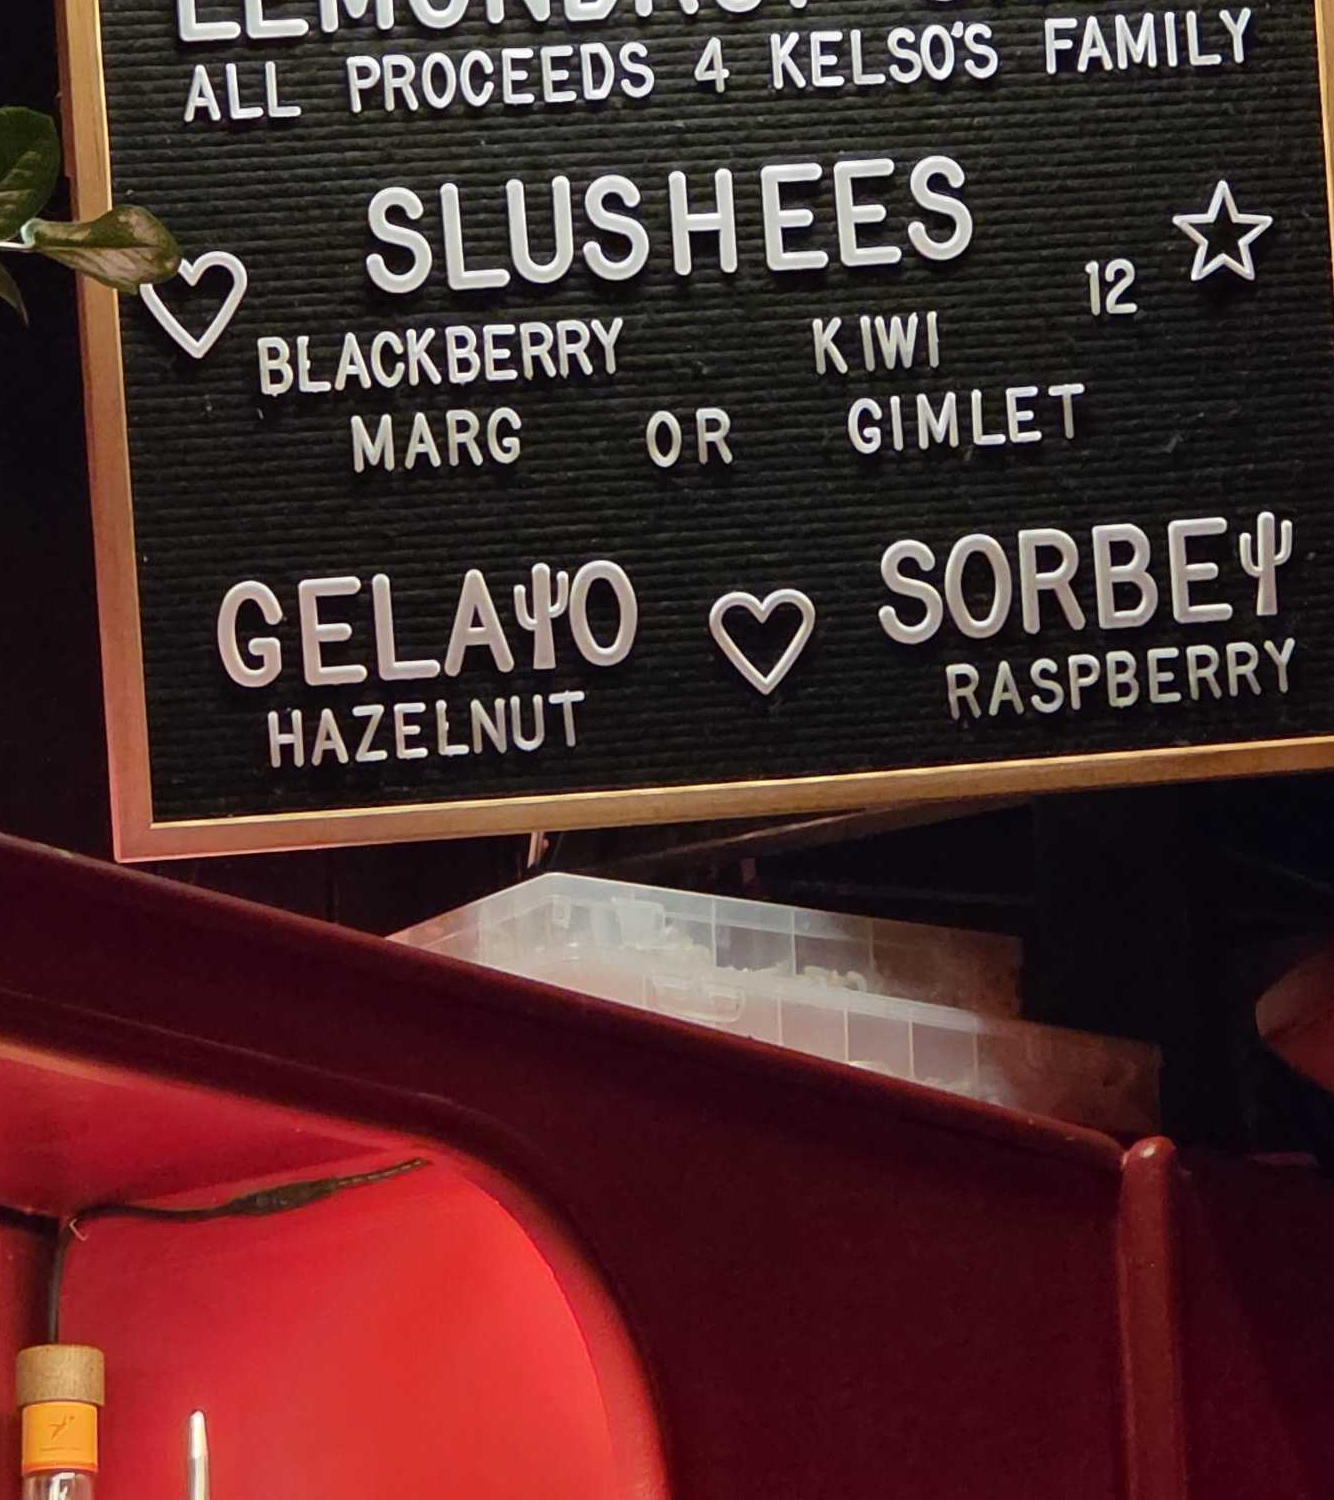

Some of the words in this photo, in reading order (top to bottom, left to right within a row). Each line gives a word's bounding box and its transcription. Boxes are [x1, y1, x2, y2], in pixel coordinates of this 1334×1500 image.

[185, 61, 301, 121] ALL
[346, 42, 654, 112] PROCEEDS
[695, 37, 729, 92] 4
[770, 21, 998, 89] KELSO'S
[1045, 8, 1251, 74] FAMILY
[366, 156, 972, 293] SLUSHEES
[1085, 259, 1137, 315] 12
[258, 317, 623, 396] BLACKBERRY
[813, 311, 939, 374] KIWI
[351, 407, 521, 472] MARG
[647, 408, 732, 467] OR
[848, 384, 1084, 453] GIMLET
[946, 638, 1295, 719] RASPBERRY
[268, 691, 584, 767] HAZELNUT
